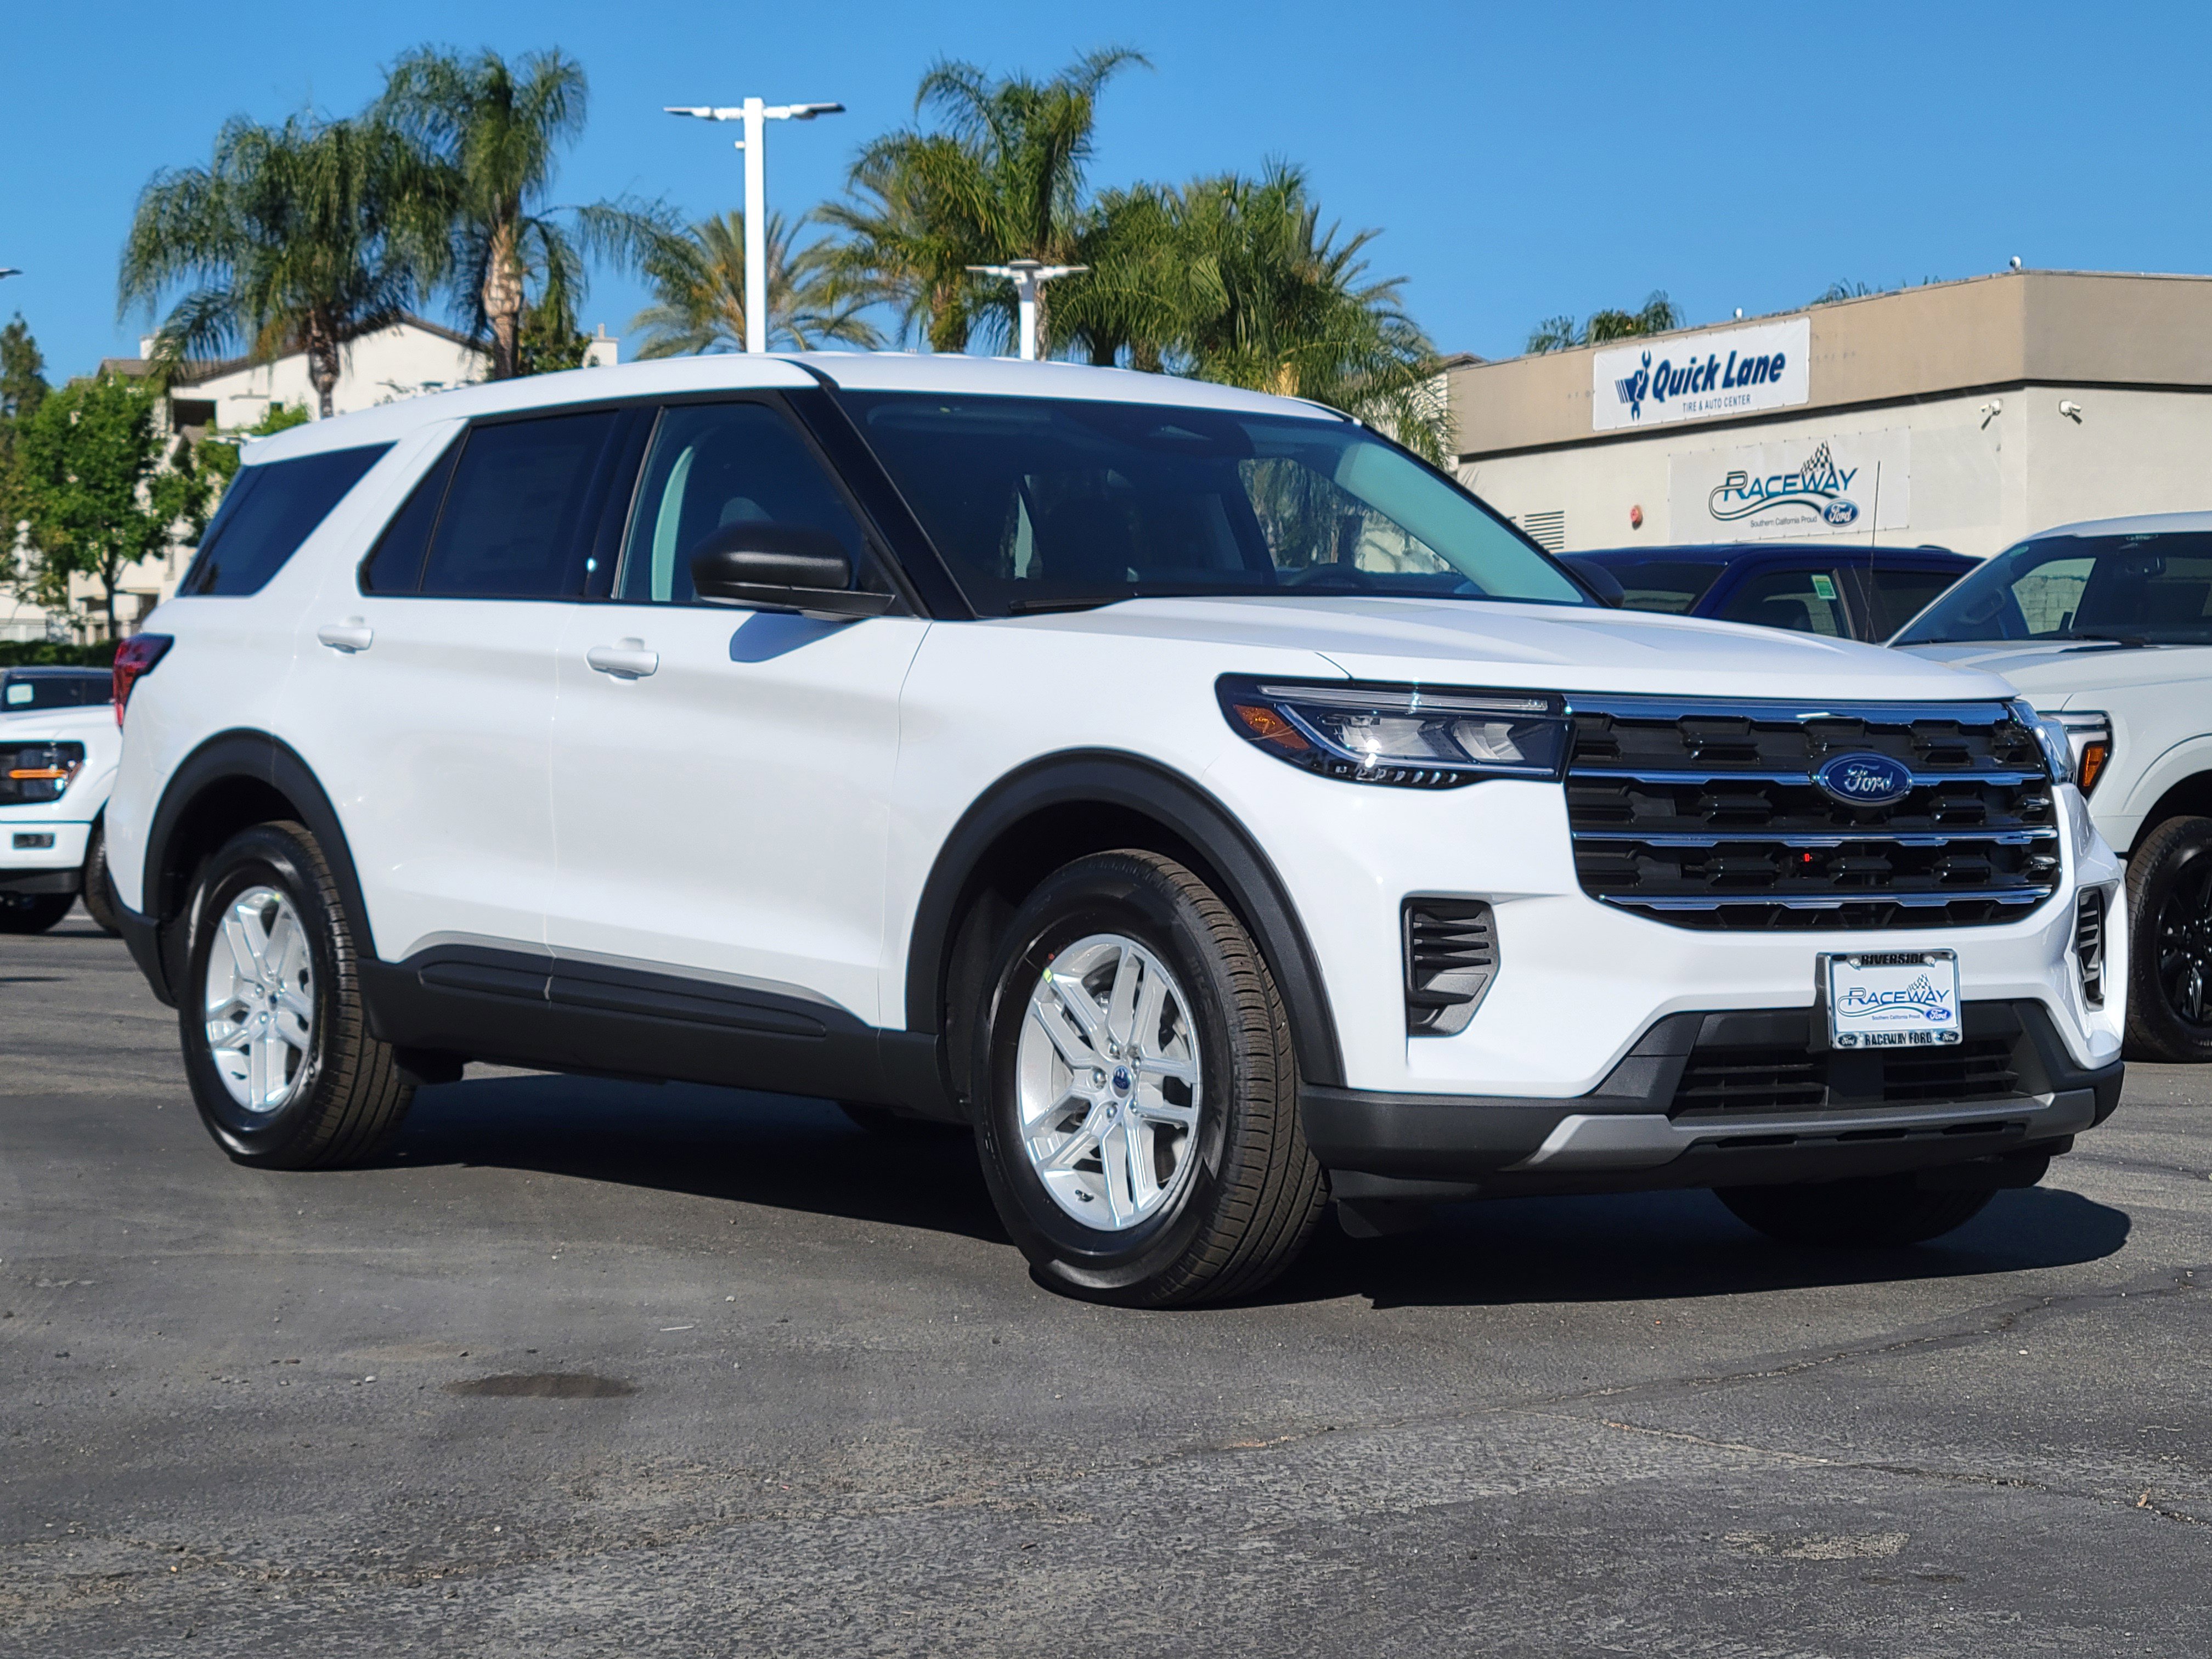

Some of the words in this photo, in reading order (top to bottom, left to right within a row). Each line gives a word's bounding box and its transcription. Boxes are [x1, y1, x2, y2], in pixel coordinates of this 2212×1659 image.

[1652, 354, 1720, 403] Quick
[1722, 350, 1786, 389] Lane
[1683, 402, 1696, 413] TIRE
[1699, 400, 1702, 410] &
[1705, 398, 1722, 409] AUTO
[1724, 394, 1751, 407] CENTER
[1724, 467, 1859, 501] RACEWAY
[1775, 517, 1799, 526] California
[1829, 503, 1852, 522] Ford
[1844, 763, 1894, 792] Ford
[1848, 987, 1950, 1006] RACEWAY
[1929, 1009, 1948, 1019] Ford
[1865, 1032, 1906, 1046] RACEWAY
[1909, 1032, 1932, 1045] FORD
